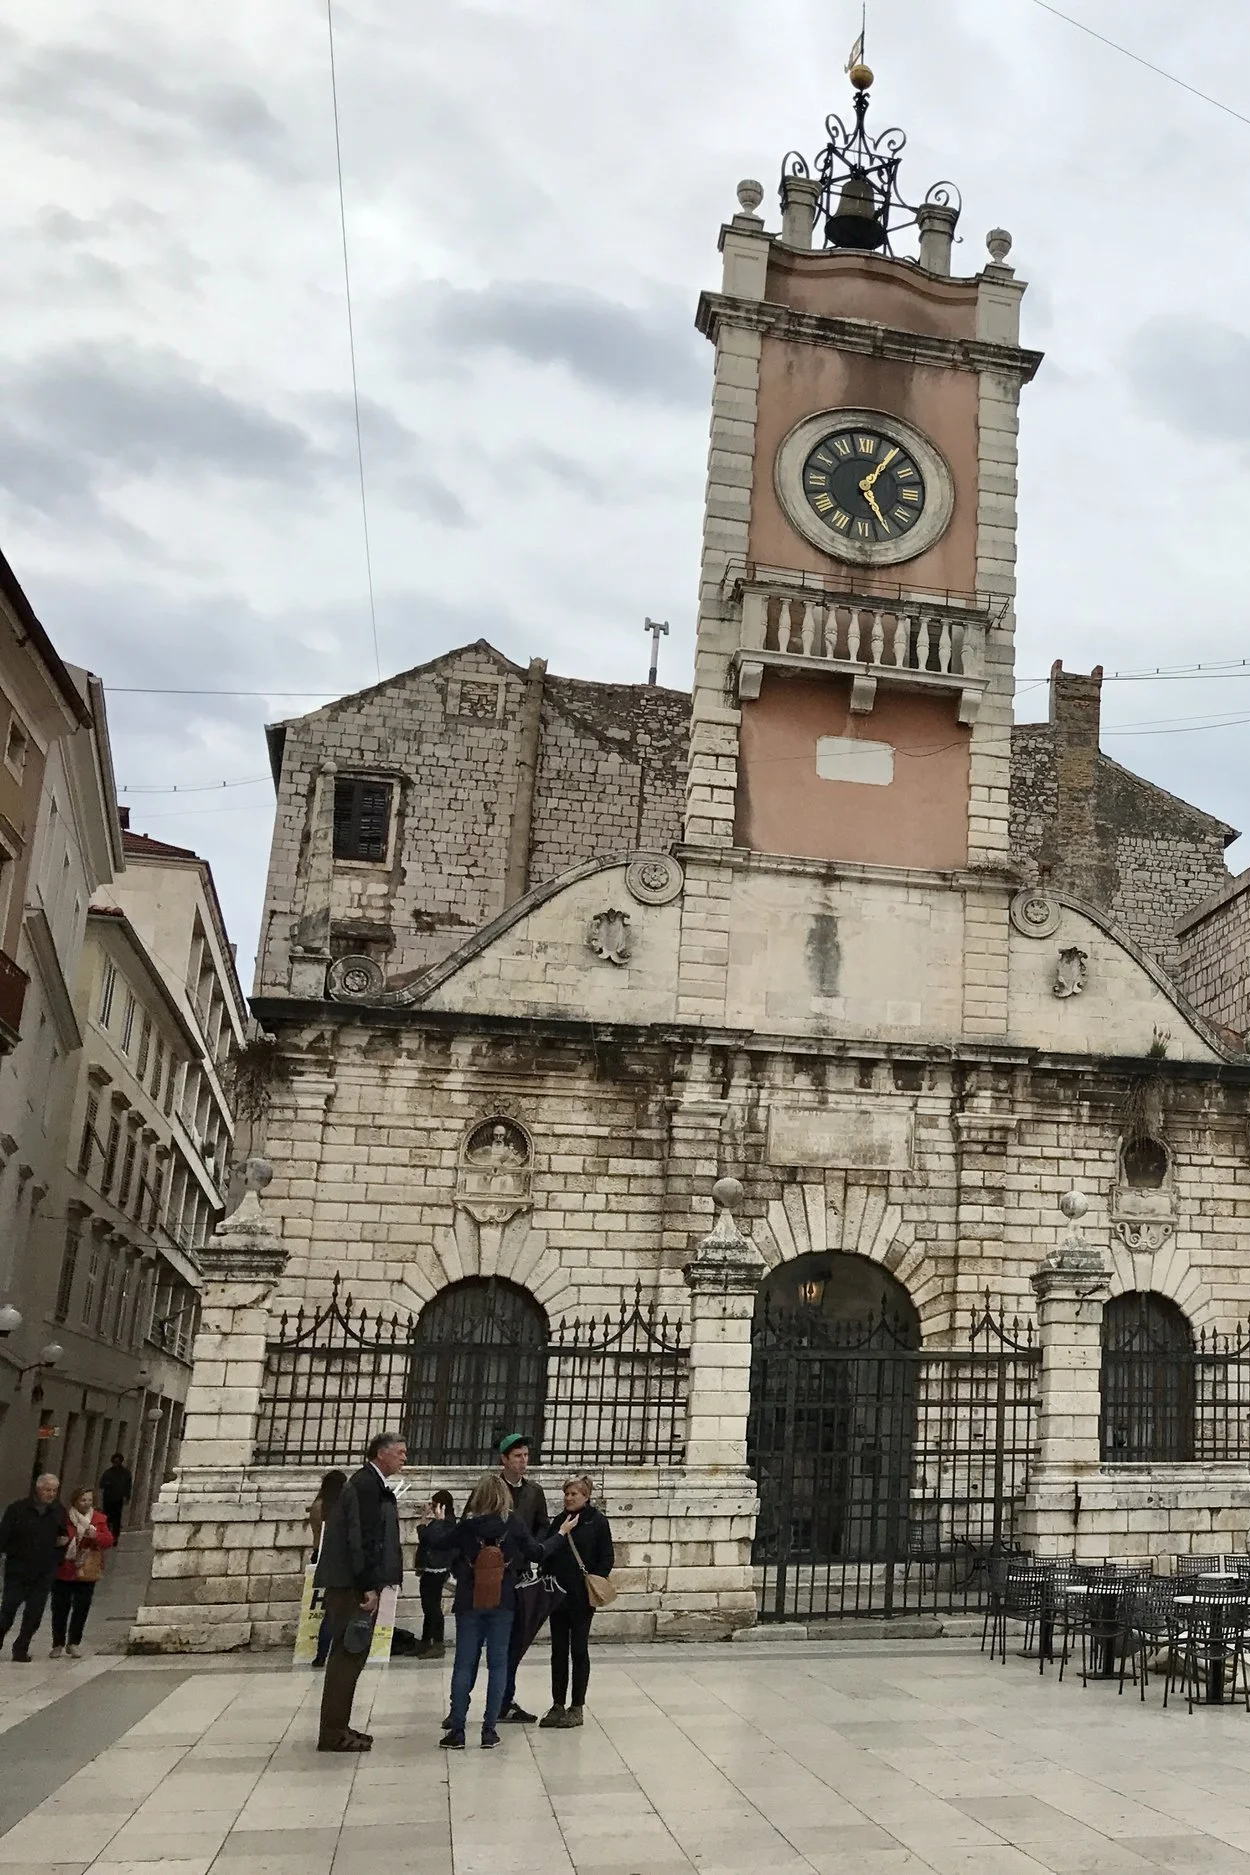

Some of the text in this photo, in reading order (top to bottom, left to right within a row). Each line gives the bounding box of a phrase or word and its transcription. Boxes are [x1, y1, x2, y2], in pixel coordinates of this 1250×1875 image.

[834, 439, 851, 456] XI
[858, 437, 874, 454] XII
[816, 452, 833, 467] X
[809, 472, 826, 486] IX
[897, 467, 914, 479] II
[813, 492, 834, 512] VIII
[902, 488, 919, 501] III
[831, 510, 850, 530] VII
[894, 506, 911, 523] IV
[858, 521, 869, 537] VI
